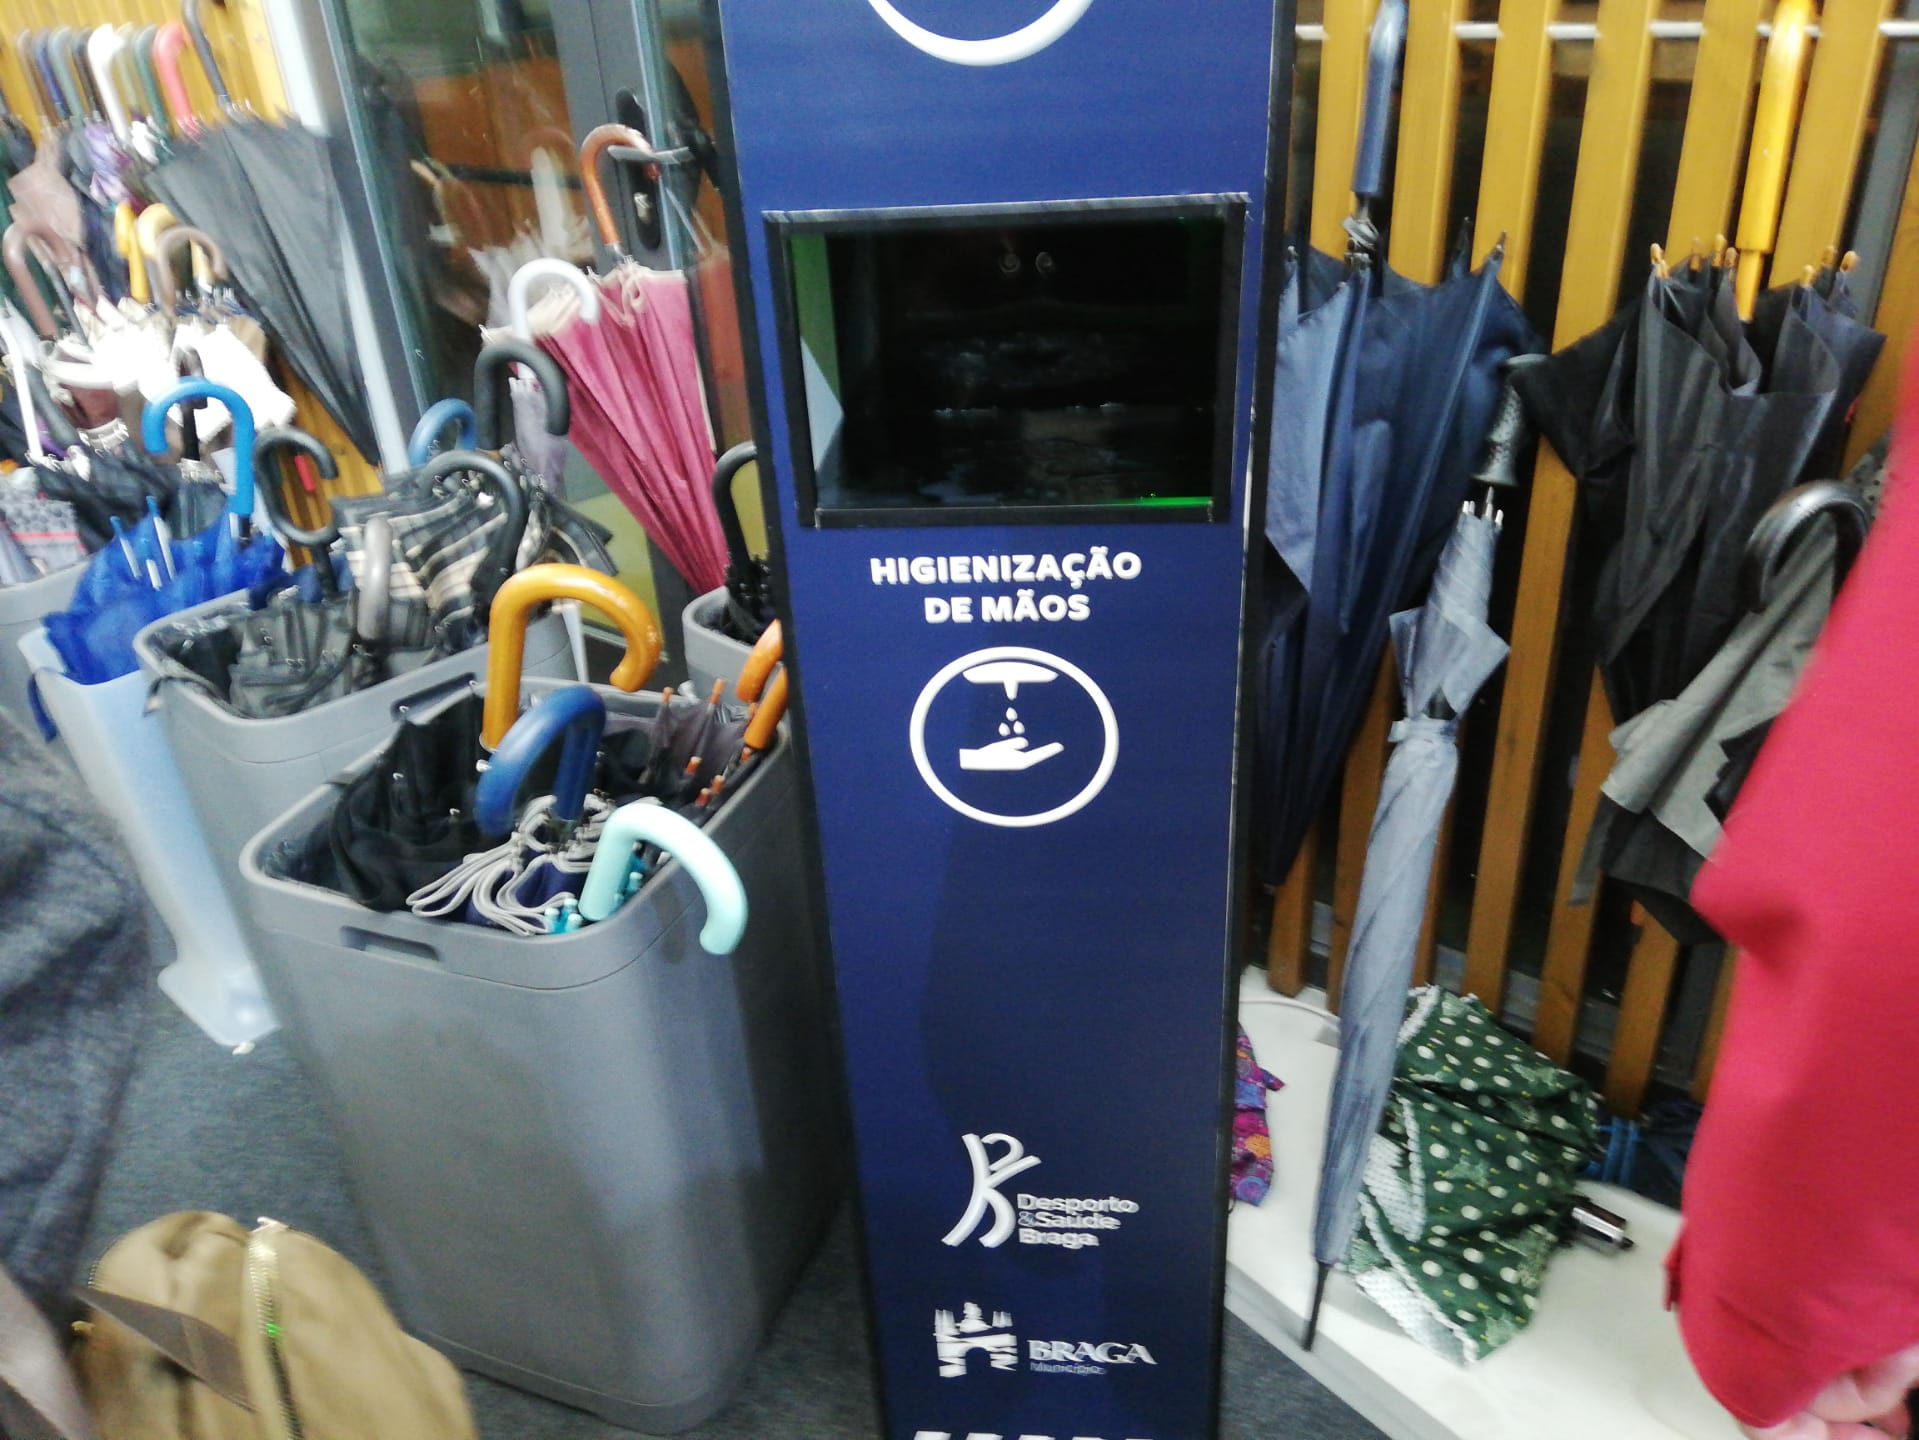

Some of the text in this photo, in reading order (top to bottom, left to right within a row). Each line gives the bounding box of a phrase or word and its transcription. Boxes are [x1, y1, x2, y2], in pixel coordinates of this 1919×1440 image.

[870, 546, 1142, 589] HIGIENIZAÇÃO
[924, 589, 1091, 623] DE MÃOS
[1017, 1194, 1140, 1215] Desporto
[1018, 1228, 1100, 1250] Braga
[1027, 1340, 1158, 1365] BRAGA
